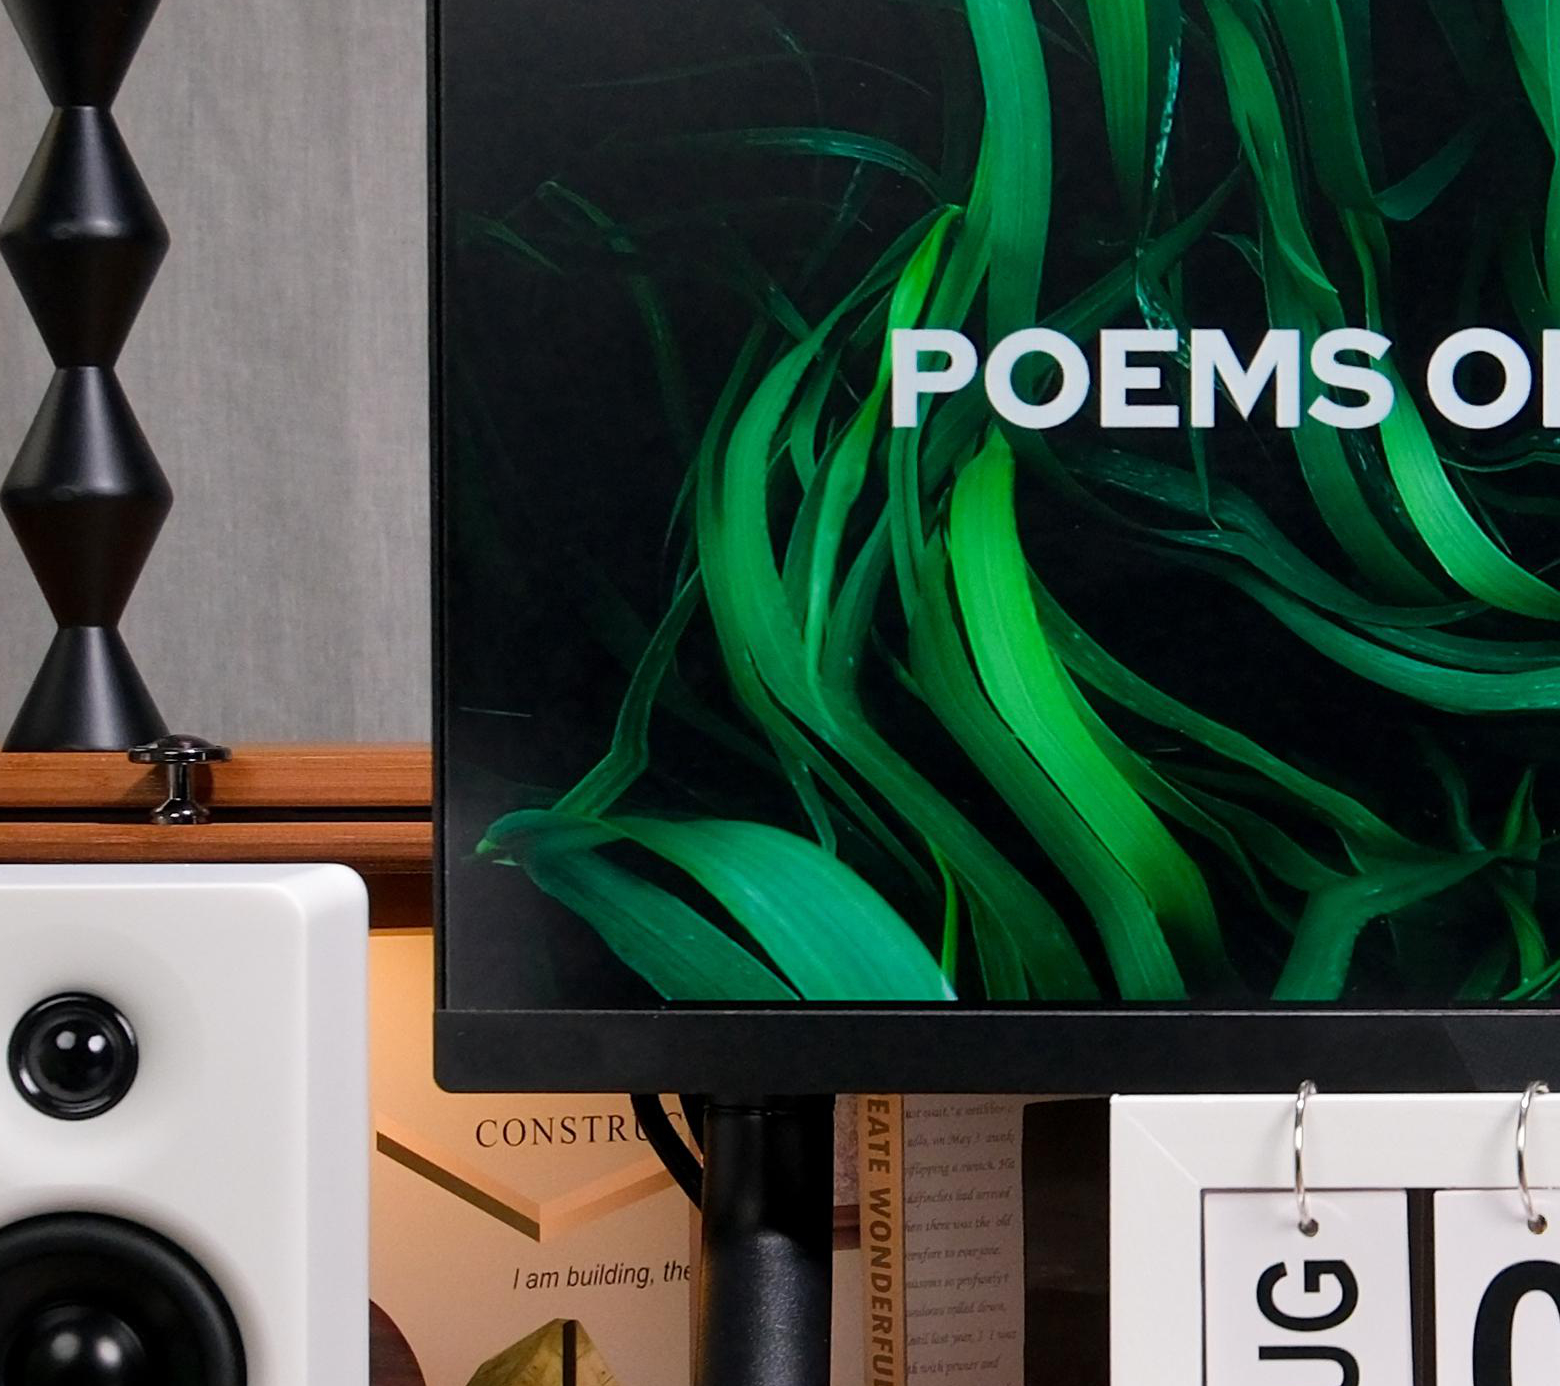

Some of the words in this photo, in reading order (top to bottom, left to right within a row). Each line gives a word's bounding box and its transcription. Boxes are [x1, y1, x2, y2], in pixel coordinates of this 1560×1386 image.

[890, 327, 1395, 430] POEMS
[513, 1268, 520, 1291] I
[525, 1271, 560, 1290] am
[566, 1261, 655, 1290] building,
